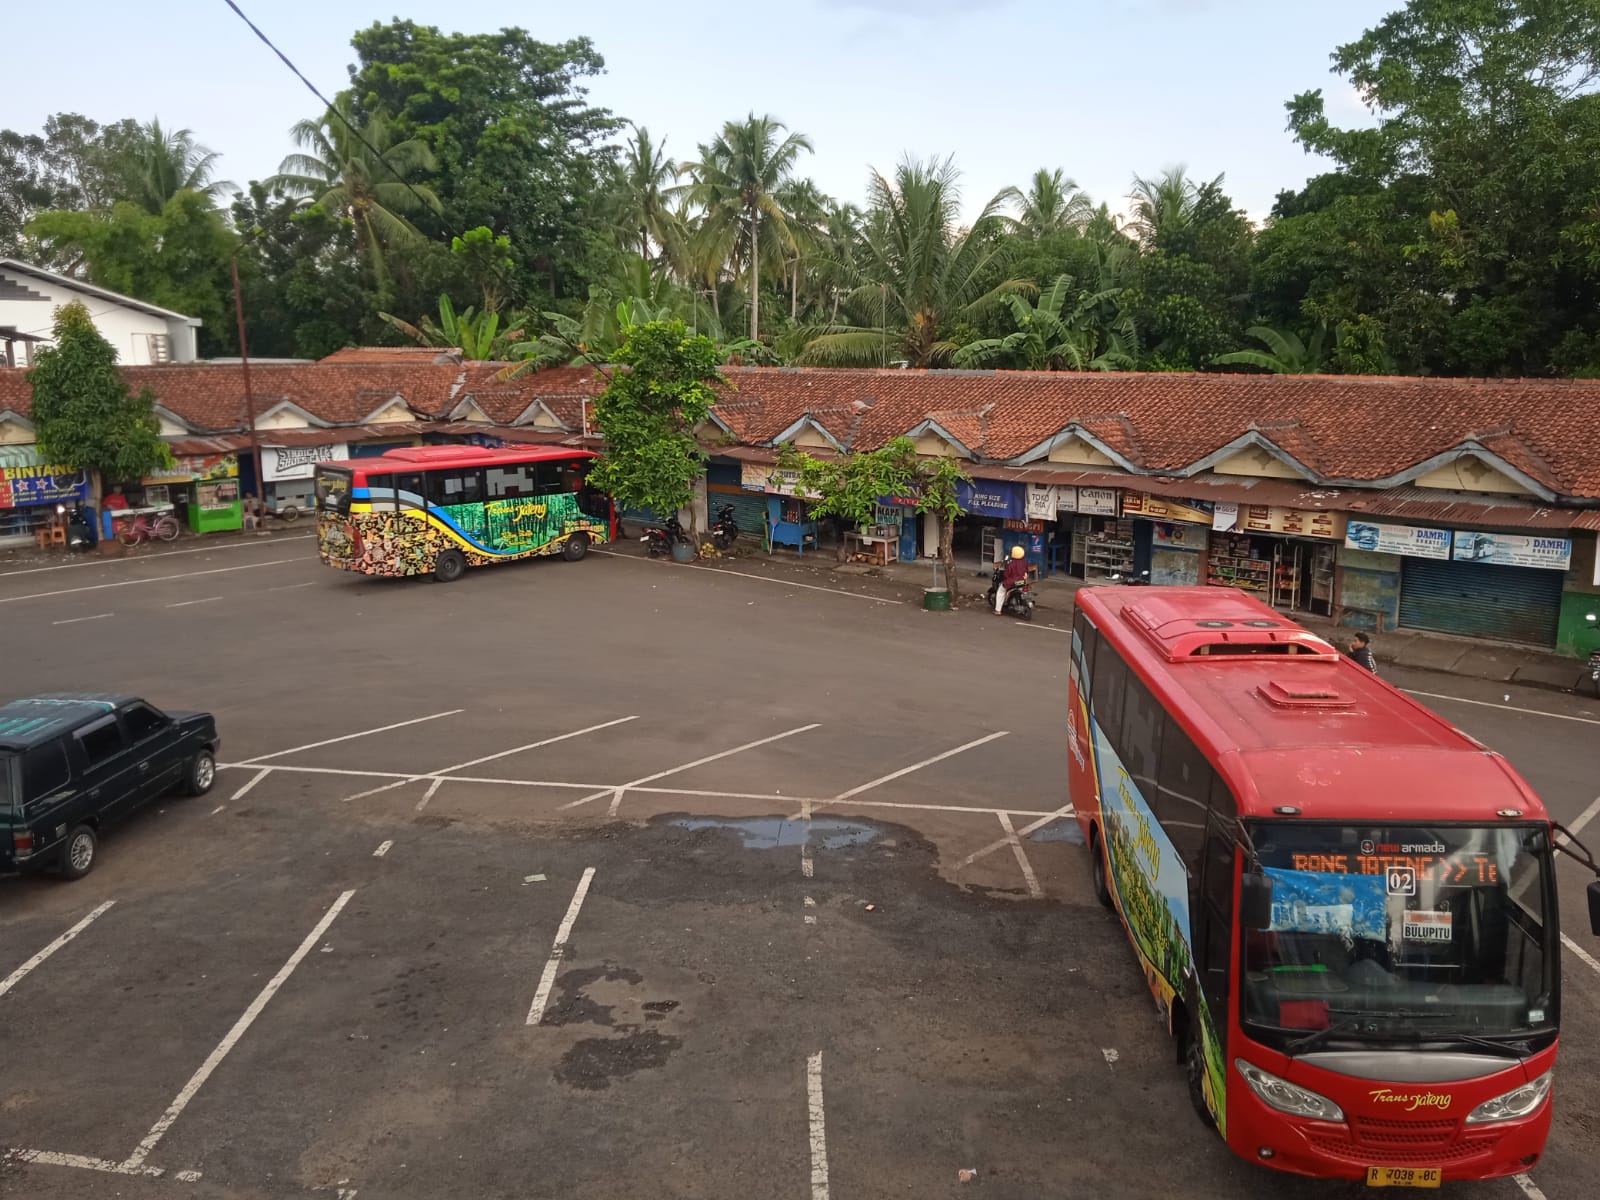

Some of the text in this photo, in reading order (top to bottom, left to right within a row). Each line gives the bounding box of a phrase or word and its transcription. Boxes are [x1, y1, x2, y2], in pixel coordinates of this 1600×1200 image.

[4, 464, 78, 480] BINTANG
[1032, 493, 1050, 502] TOKO
[1080, 488, 1112, 500] Canon
[1417, 529, 1447, 541] DAMRI
[1533, 538, 1567, 550] DAMRI
[1376, 841, 1445, 853] new armada
[1292, 854, 1347, 875] RANS
[1390, 872, 1413, 890] 02
[1405, 926, 1450, 939] BULUPITU
[1369, 1089, 1408, 1103] Trans
[1371, 1168, 1379, 1180] R
